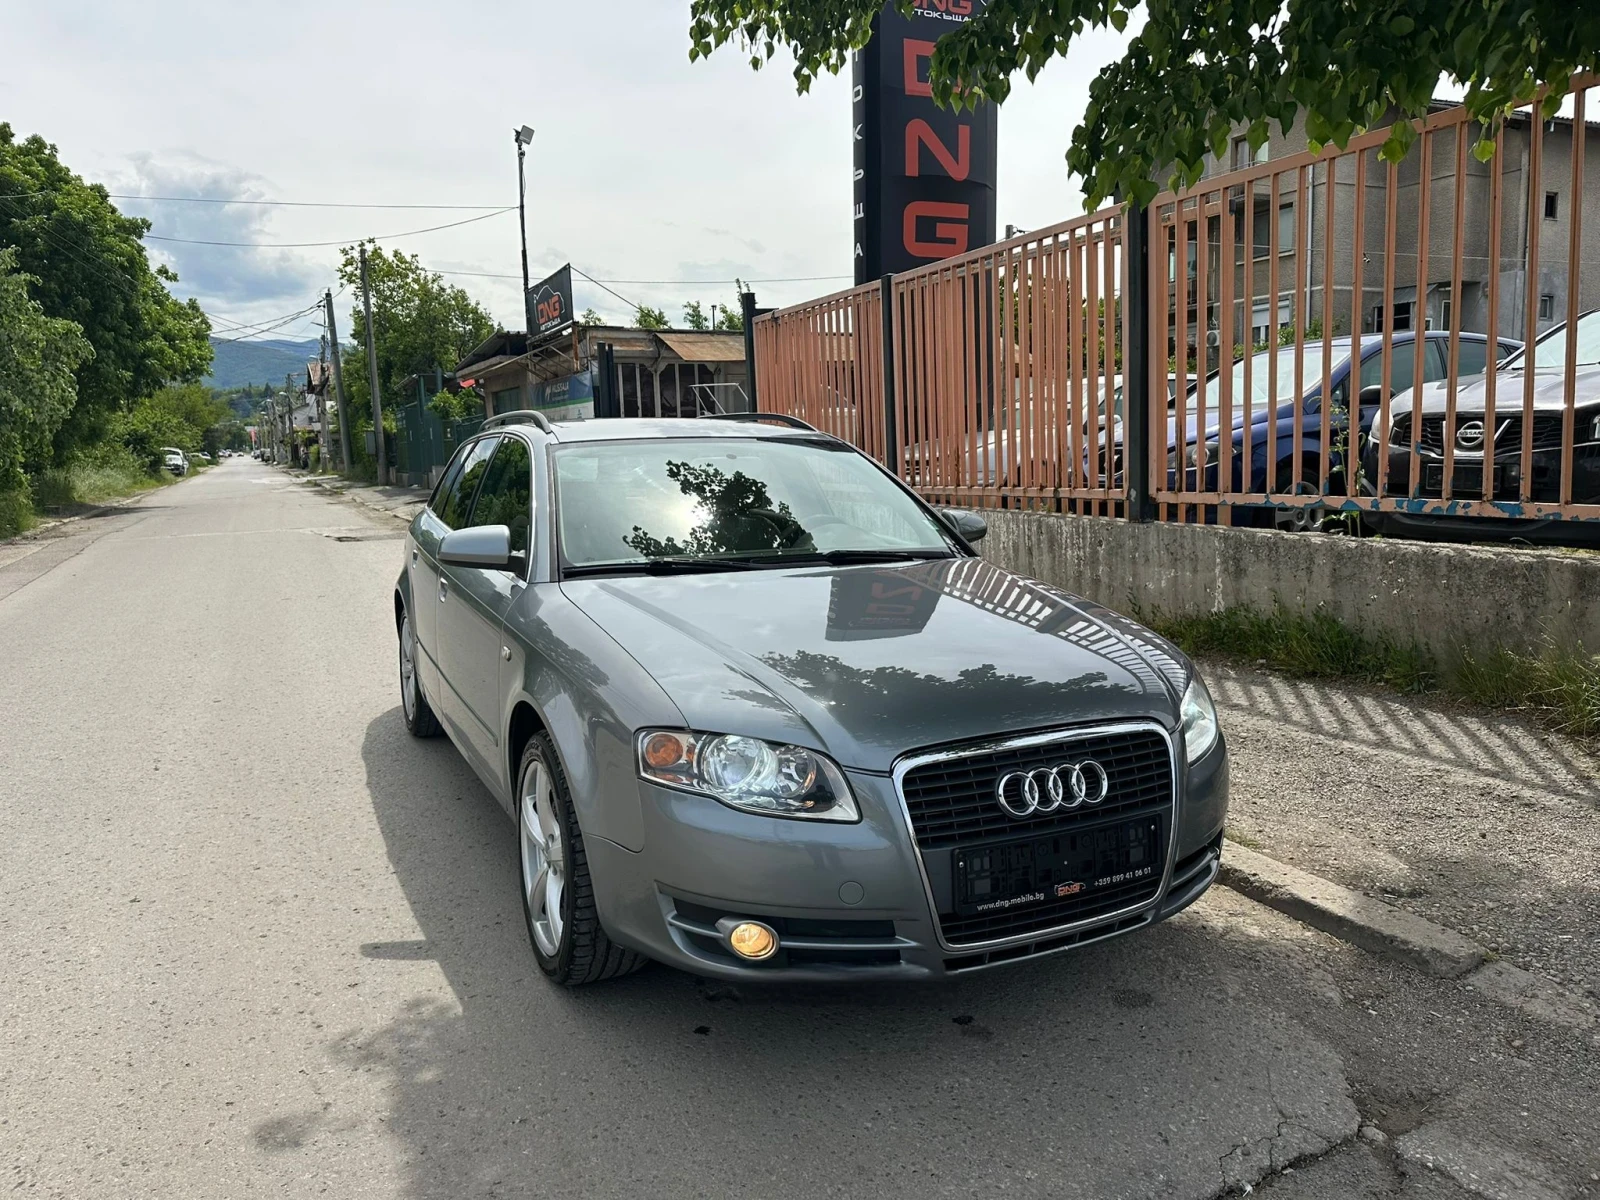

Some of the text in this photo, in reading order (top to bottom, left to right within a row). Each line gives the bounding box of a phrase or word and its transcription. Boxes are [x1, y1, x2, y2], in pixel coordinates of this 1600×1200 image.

[913, 0, 972, 15] NG
[537, 295, 560, 325] DNG
[1094, 876, 1111, 887] +359
[1112, 873, 1124, 883] 899
[1125, 871, 1133, 879] 41
